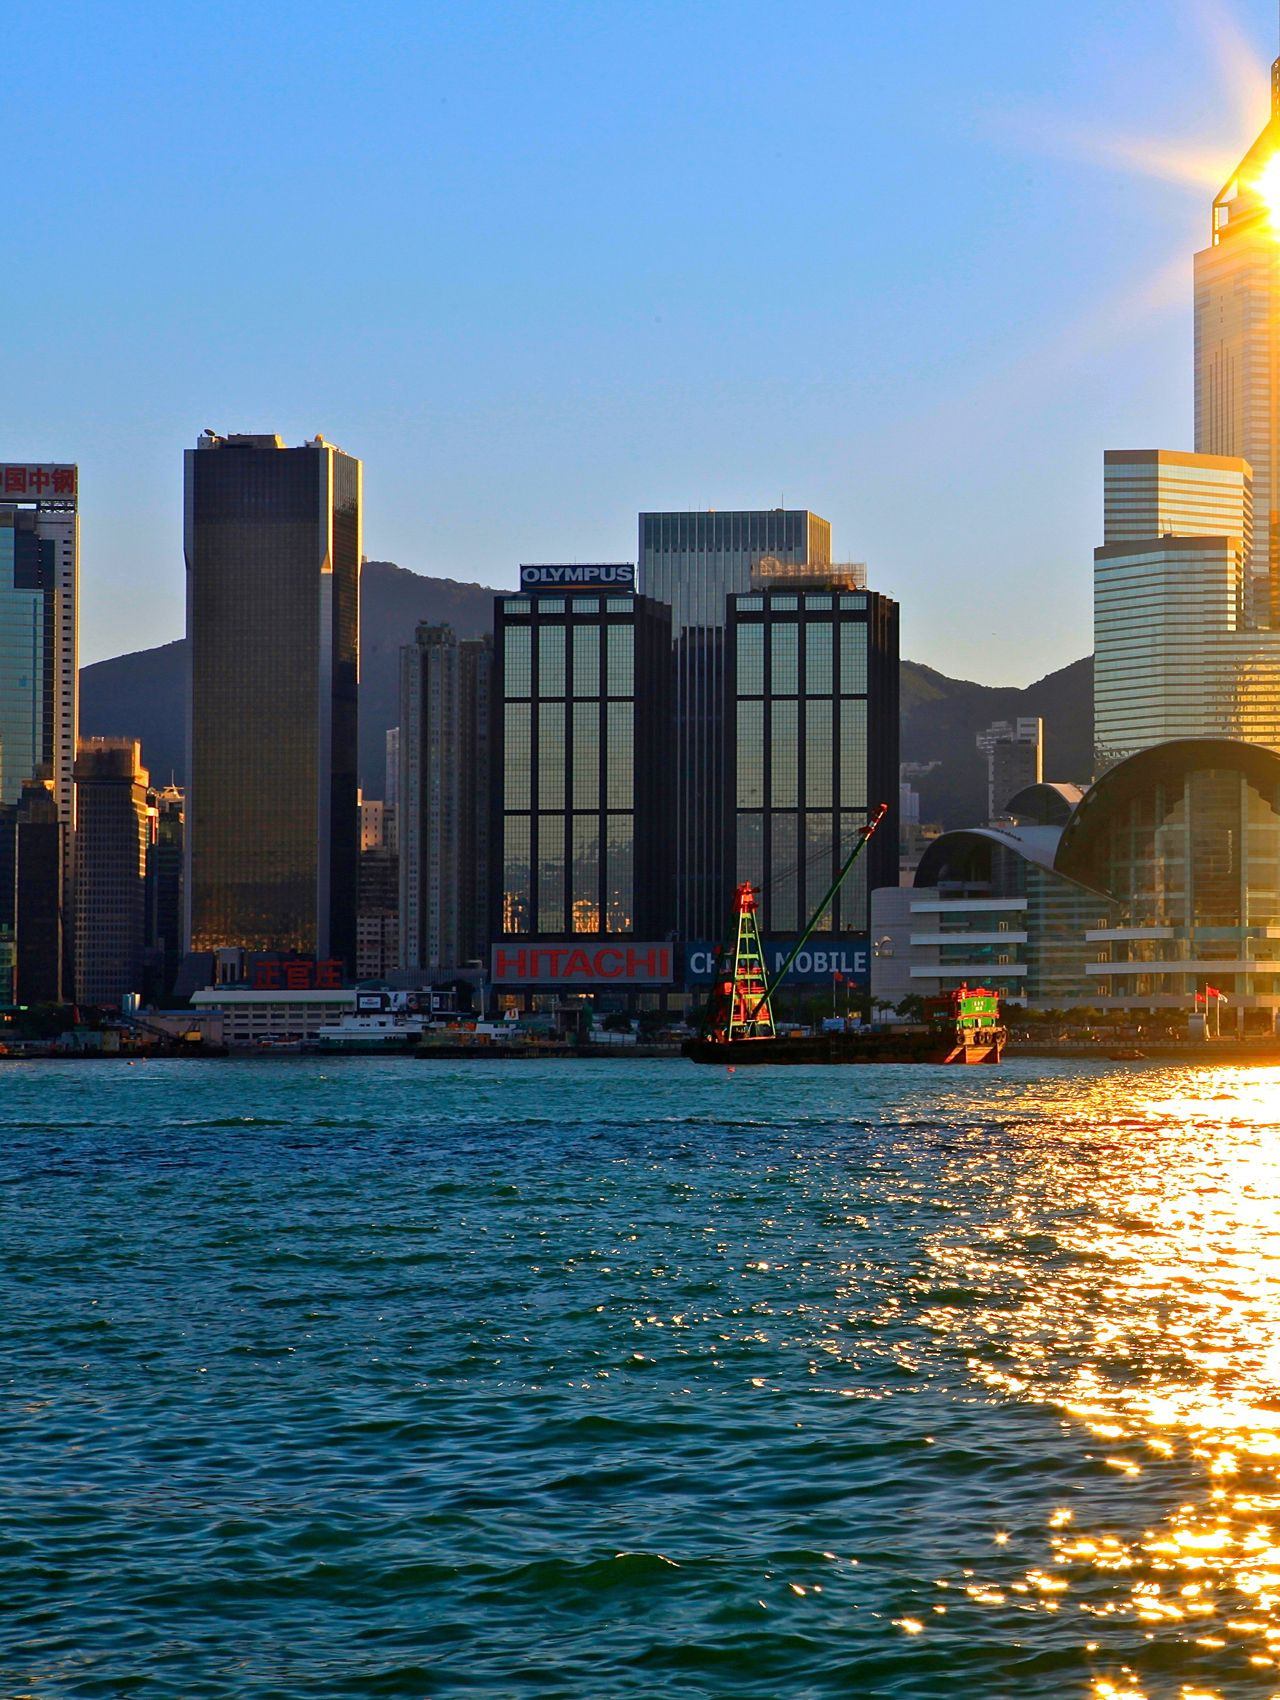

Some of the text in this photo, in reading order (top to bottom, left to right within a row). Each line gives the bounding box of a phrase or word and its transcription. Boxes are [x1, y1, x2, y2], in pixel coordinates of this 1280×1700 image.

[0, 467, 74, 494] 国中钢
[522, 567, 632, 582] OLYMPUS
[253, 959, 344, 989] 正官庄
[496, 948, 669, 978] HITACHI
[775, 951, 867, 973] MOBILE
